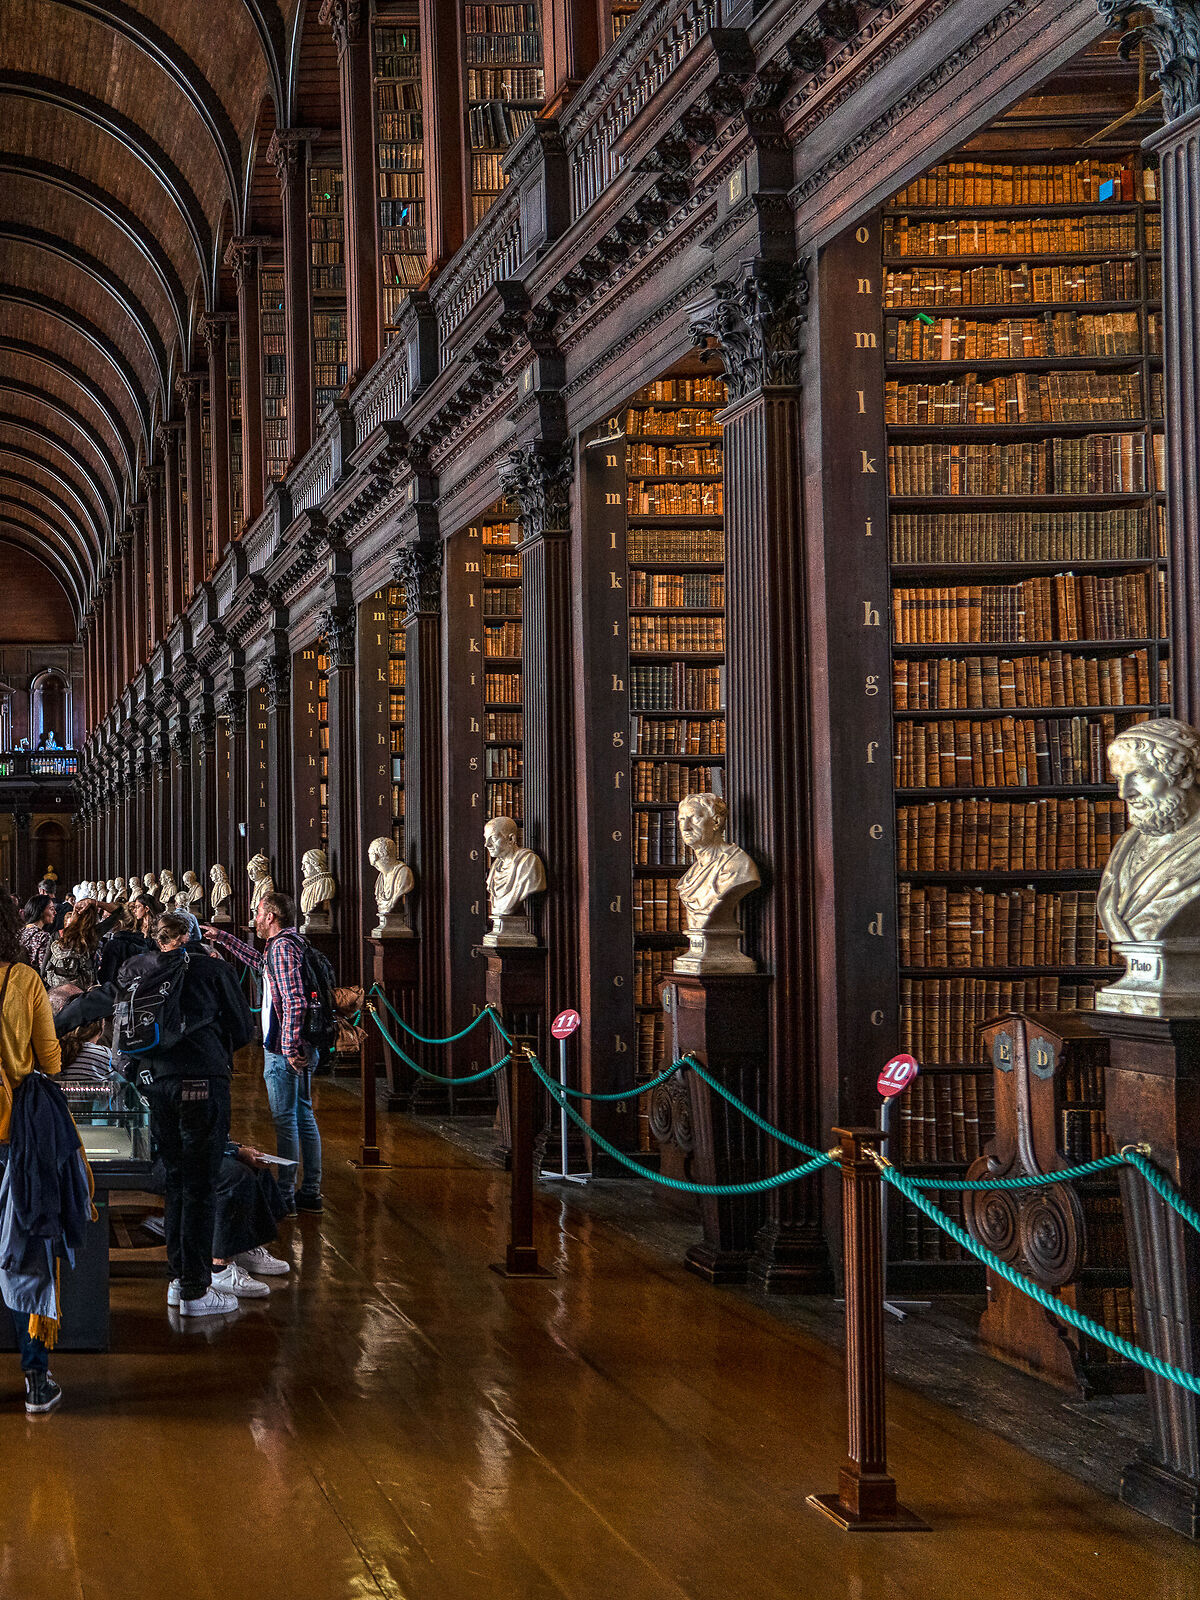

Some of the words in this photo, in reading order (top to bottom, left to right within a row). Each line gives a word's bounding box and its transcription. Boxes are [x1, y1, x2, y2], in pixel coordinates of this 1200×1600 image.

[856, 227, 869, 244] o
[857, 278, 872, 294] n
[854, 331, 877, 348] m
[856, 391, 867, 414] l
[606, 454, 618, 467] n
[860, 450, 877, 473] k
[605, 493, 622, 505] m
[469, 527, 478, 537] n
[865, 517, 872, 536] i
[610, 532, 617, 549] l
[465, 562, 480, 573] m
[609, 571, 623, 588] k
[373, 611, 385, 621] m
[863, 601, 880, 626] h
[469, 638, 480, 653] k
[303, 650, 315, 660] m
[378, 668, 386, 681] k
[611, 674, 625, 691] h
[865, 674, 880, 697] g
[308, 703, 315, 713] k
[470, 717, 479, 732] h
[378, 733, 385, 745] h
[612, 731, 625, 748] g
[309, 754, 315, 766] h
[469, 757, 479, 770] g
[378, 765, 385, 776] g
[310, 787, 315, 796] g
[612, 830, 622, 841] e
[869, 824, 883, 839] e
[470, 849, 479, 860] e
[471, 901, 479, 914] d
[610, 895, 622, 913] d
[868, 913, 883, 936] d
[1130, 958, 1152, 972] Plato
[614, 975, 624, 987] c
[557, 1014, 576, 1028] 11
[871, 1010, 883, 1026] c
[615, 1034, 627, 1053] b
[1000, 1044, 1010, 1062] E
[1037, 1050, 1048, 1067] D
[884, 1060, 910, 1081] 10
